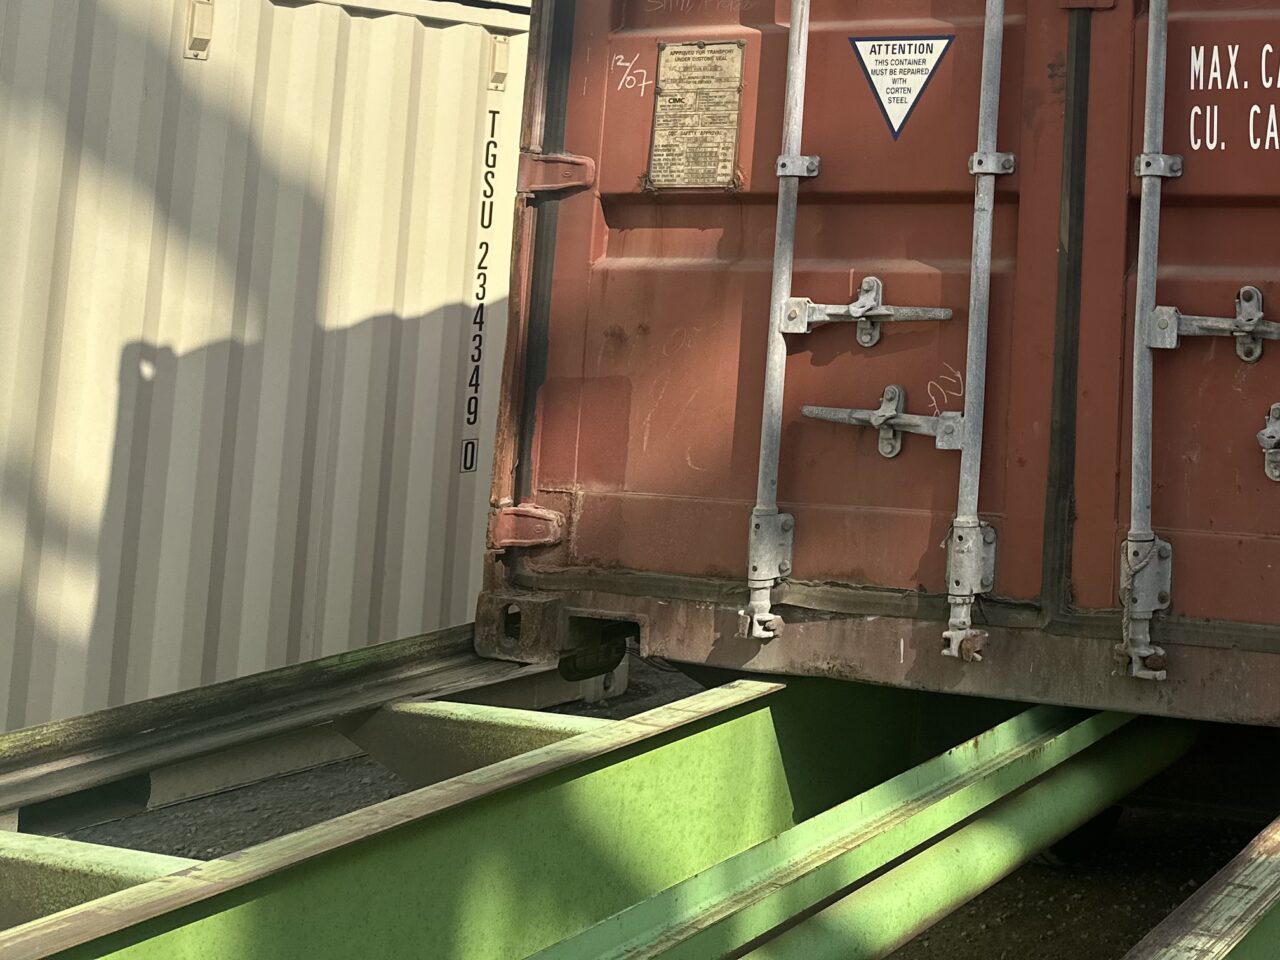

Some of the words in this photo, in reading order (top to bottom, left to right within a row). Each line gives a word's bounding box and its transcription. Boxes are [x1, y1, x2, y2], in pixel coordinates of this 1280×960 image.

[869, 43, 934, 55] ATTENTION
[890, 58, 927, 66] CONTAINER
[899, 68, 929, 76] REPAIRED
[1190, 44, 1249, 90] MAX.
[886, 87, 912, 95] CORTEN
[1190, 105, 1225, 150] CU.
[480, 110, 500, 229] TGSU
[466, 242, 489, 425] 234349
[462, 441, 475, 471] 0
